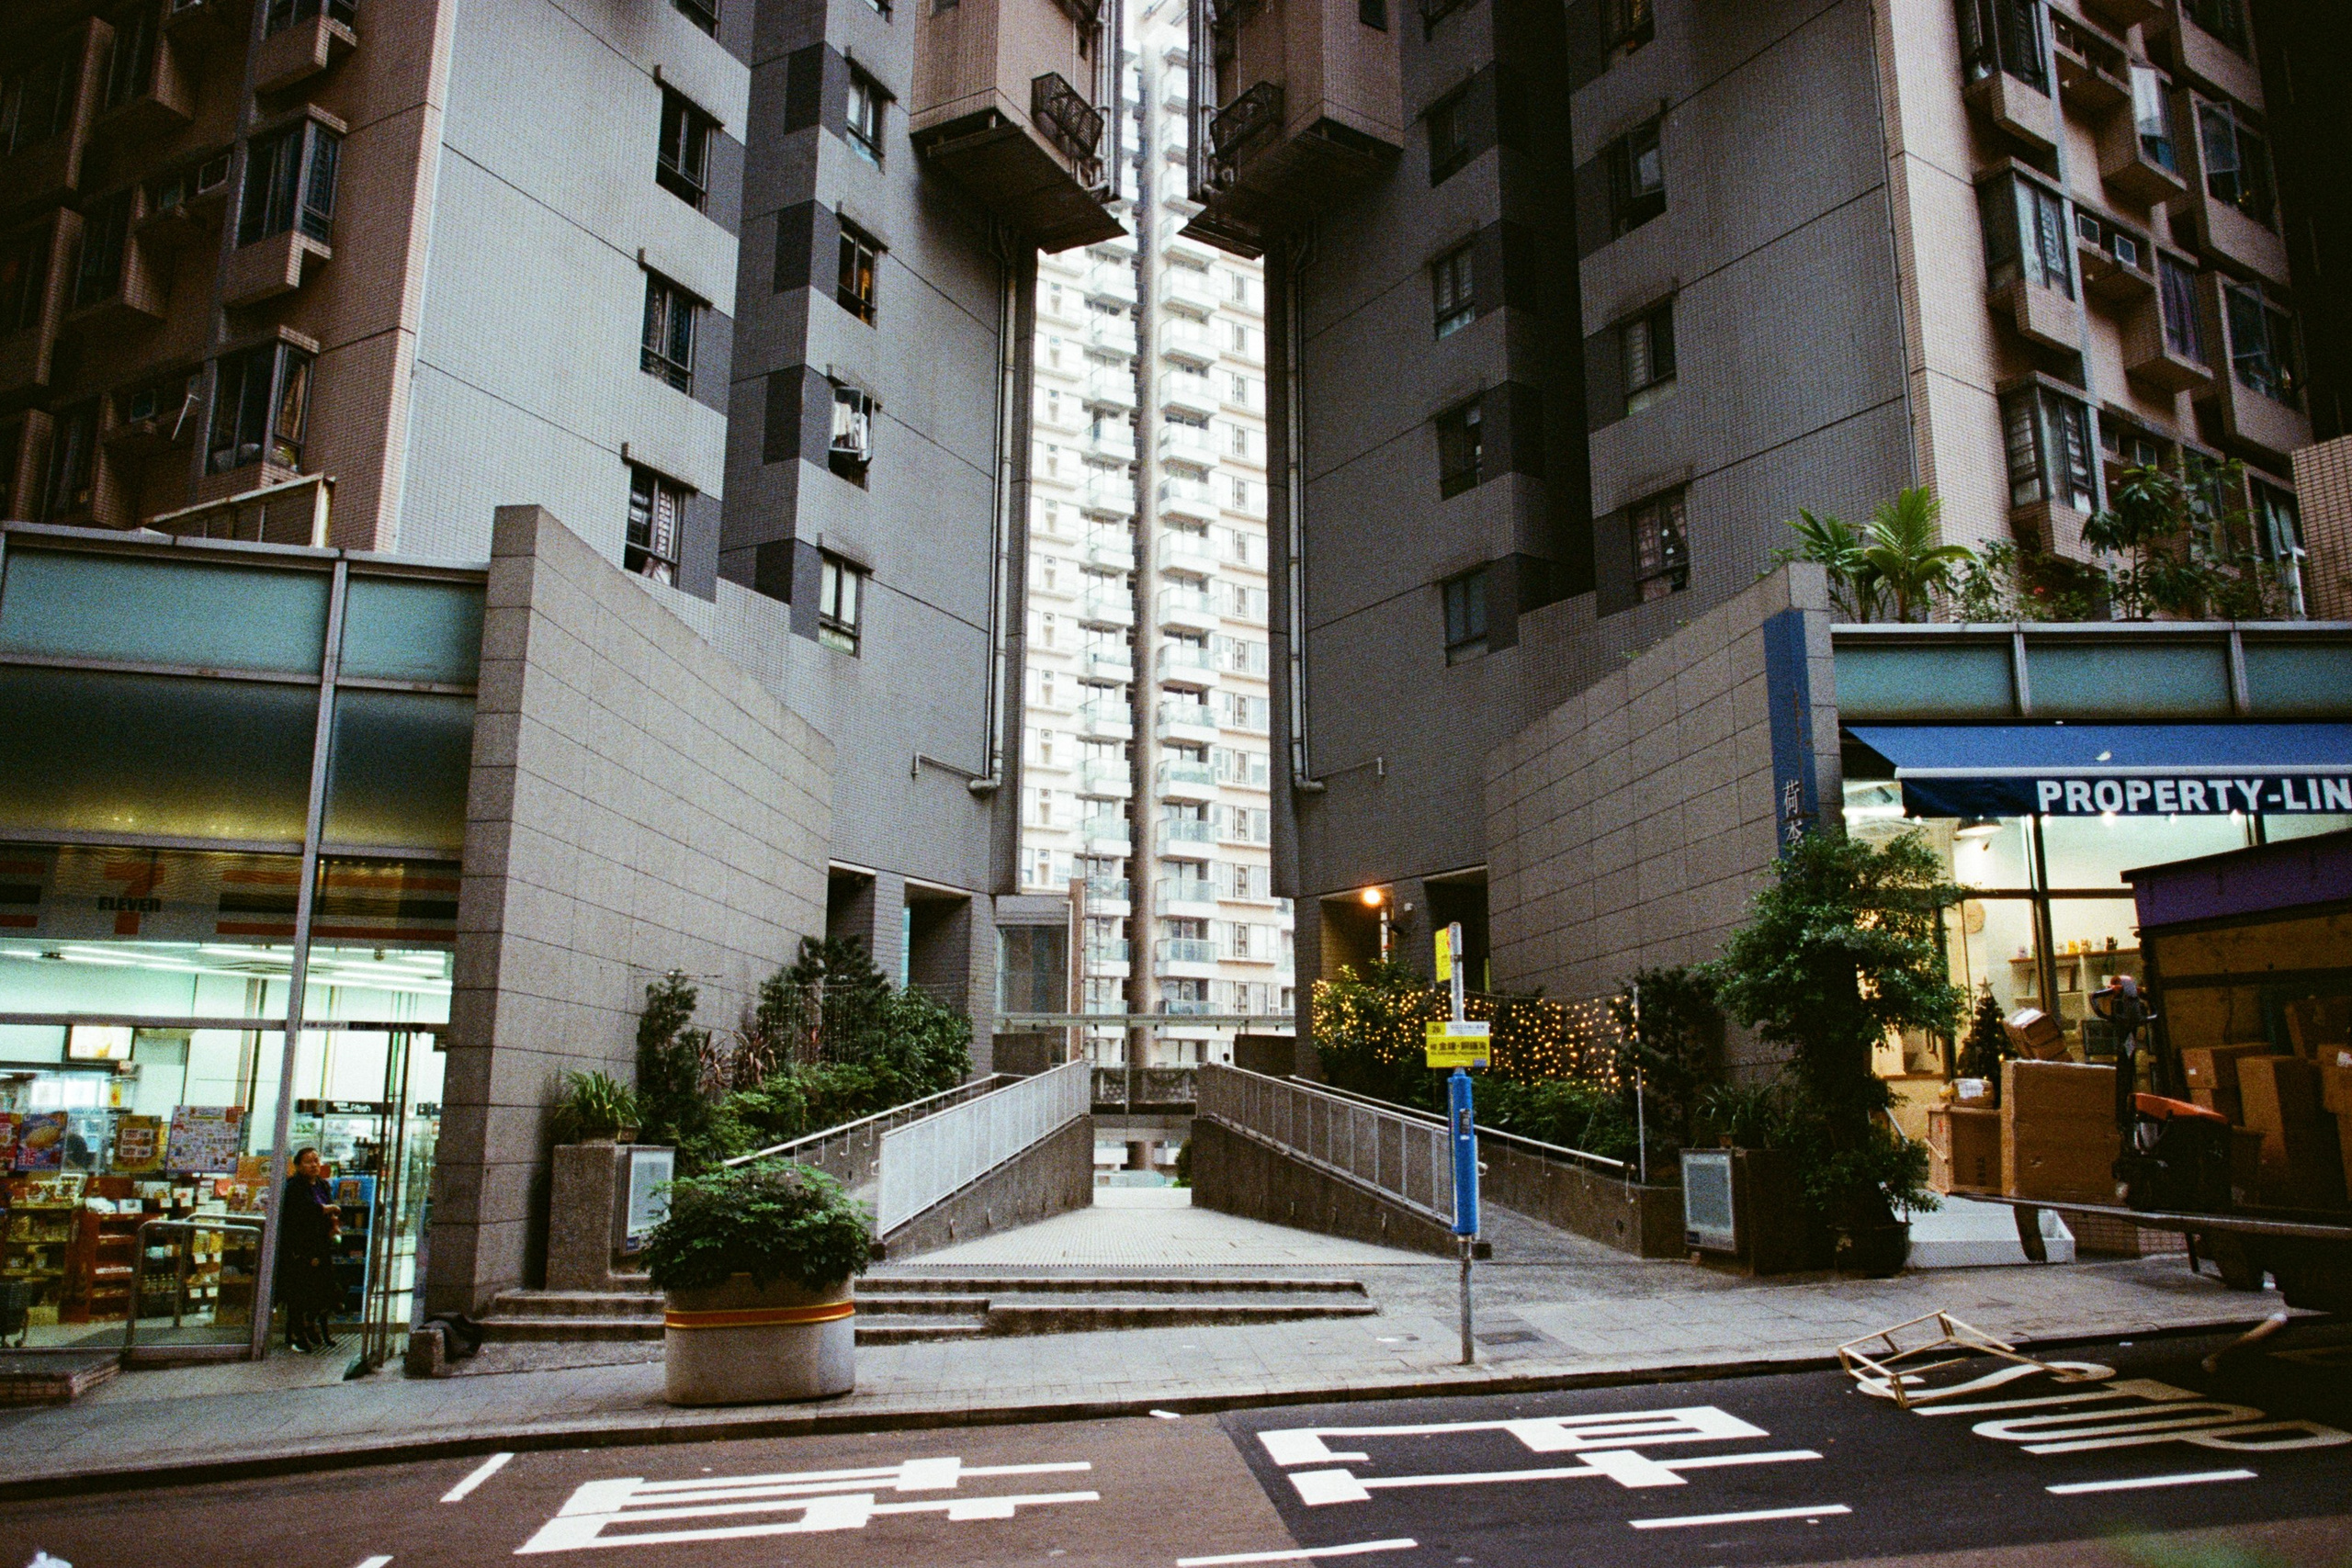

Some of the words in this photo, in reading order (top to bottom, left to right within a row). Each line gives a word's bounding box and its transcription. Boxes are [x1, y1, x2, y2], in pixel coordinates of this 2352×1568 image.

[1782, 779, 1805, 875] 荷李
[103, 862, 166, 935] 7
[1857, 1361, 2352, 1455] STOP
